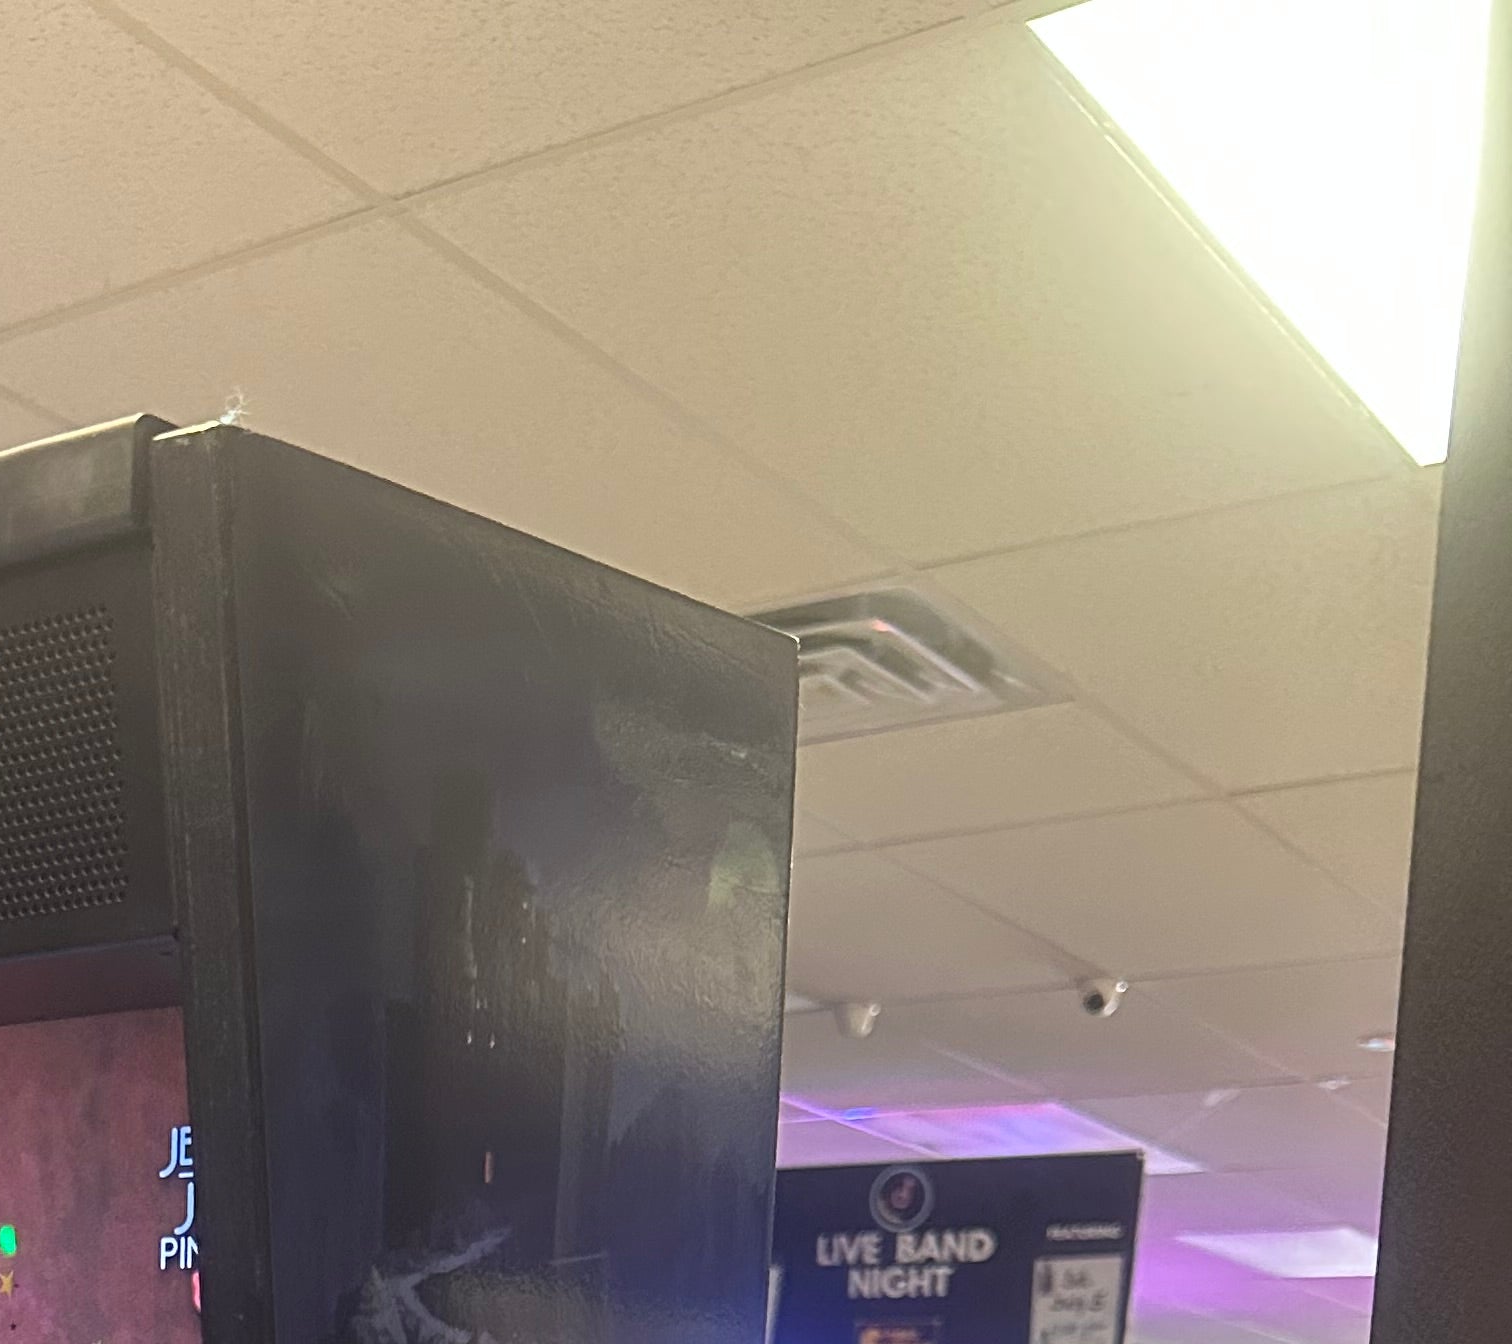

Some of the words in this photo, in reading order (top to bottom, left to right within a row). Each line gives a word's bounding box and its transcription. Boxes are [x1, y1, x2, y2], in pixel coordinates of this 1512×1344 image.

[815, 1233, 882, 1266] LIVE
[894, 1228, 997, 1264] BAND
[847, 1266, 951, 1300] NIGHT
